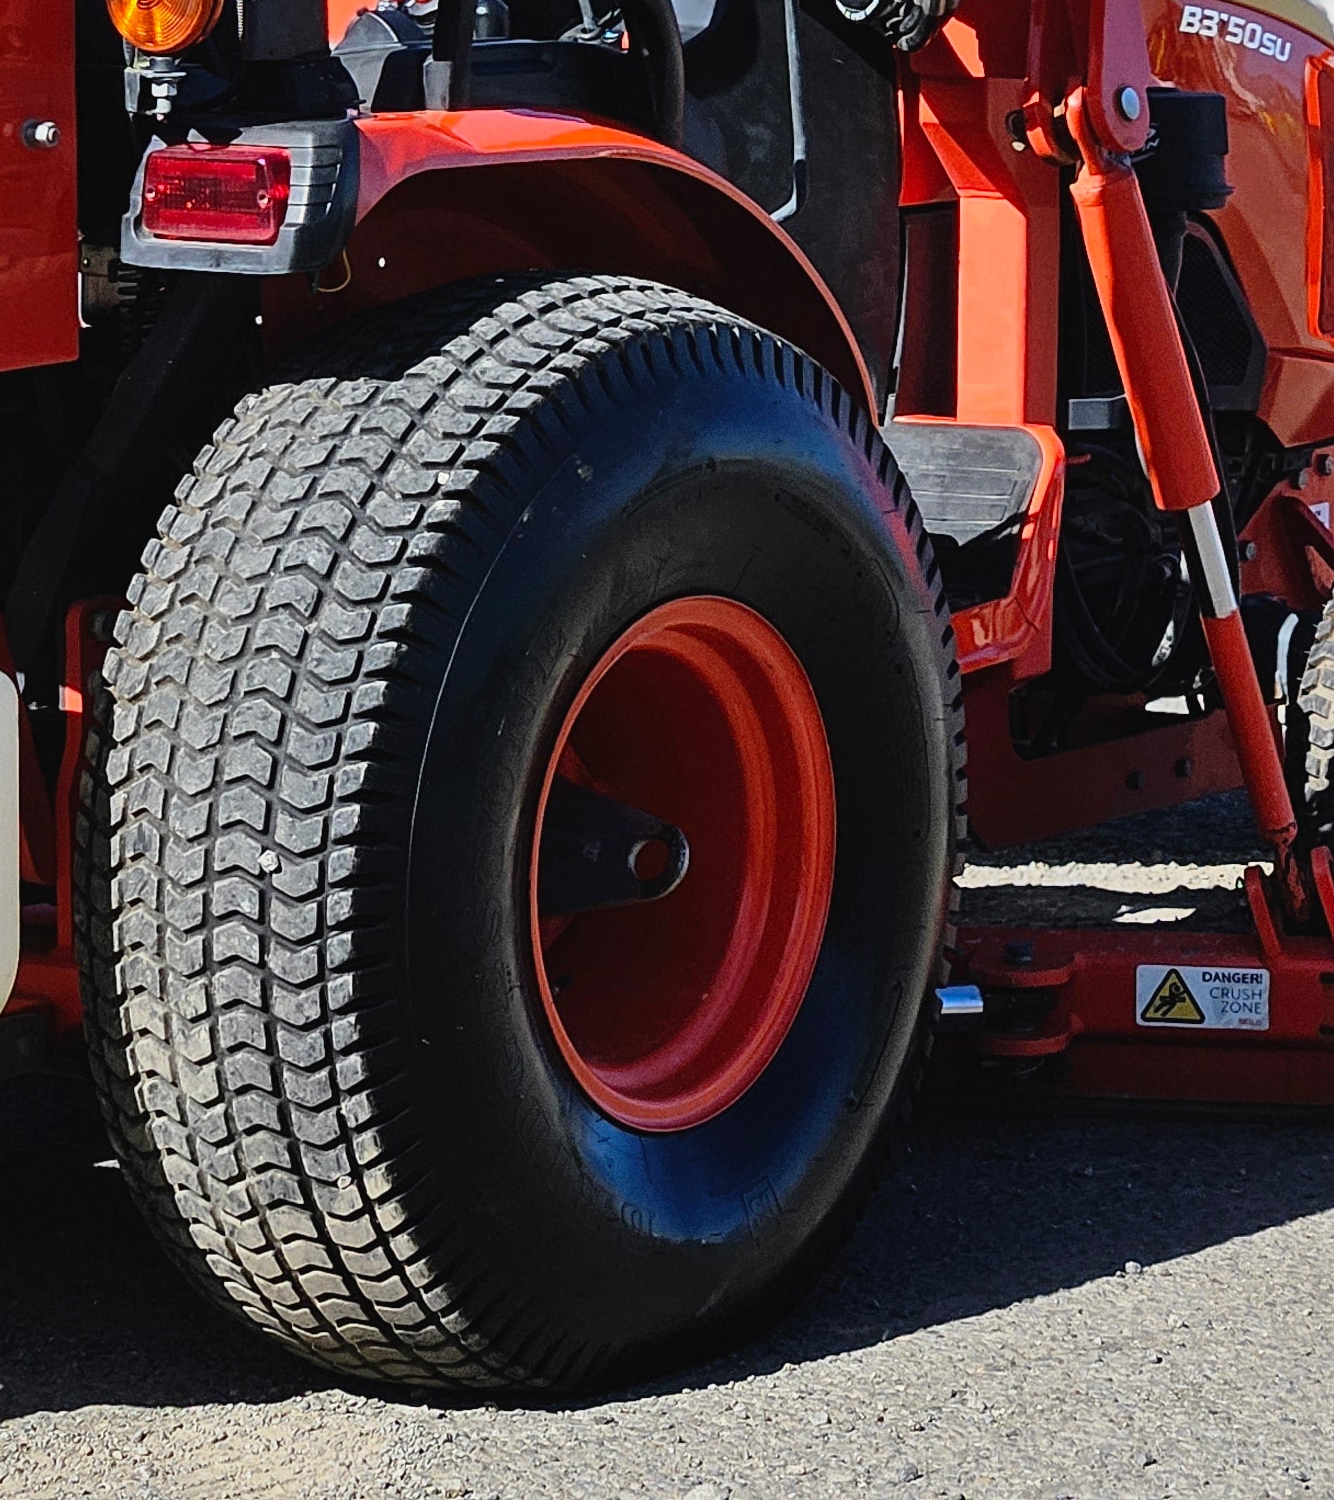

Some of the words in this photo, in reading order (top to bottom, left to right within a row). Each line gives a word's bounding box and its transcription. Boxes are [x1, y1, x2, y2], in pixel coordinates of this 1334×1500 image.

[1179, 5, 1291, 62] B350SU
[1202, 971, 1263, 984] DANGER!
[1209, 987, 1262, 1001] CRUSH
[1221, 1001, 1262, 1014] ZONE
